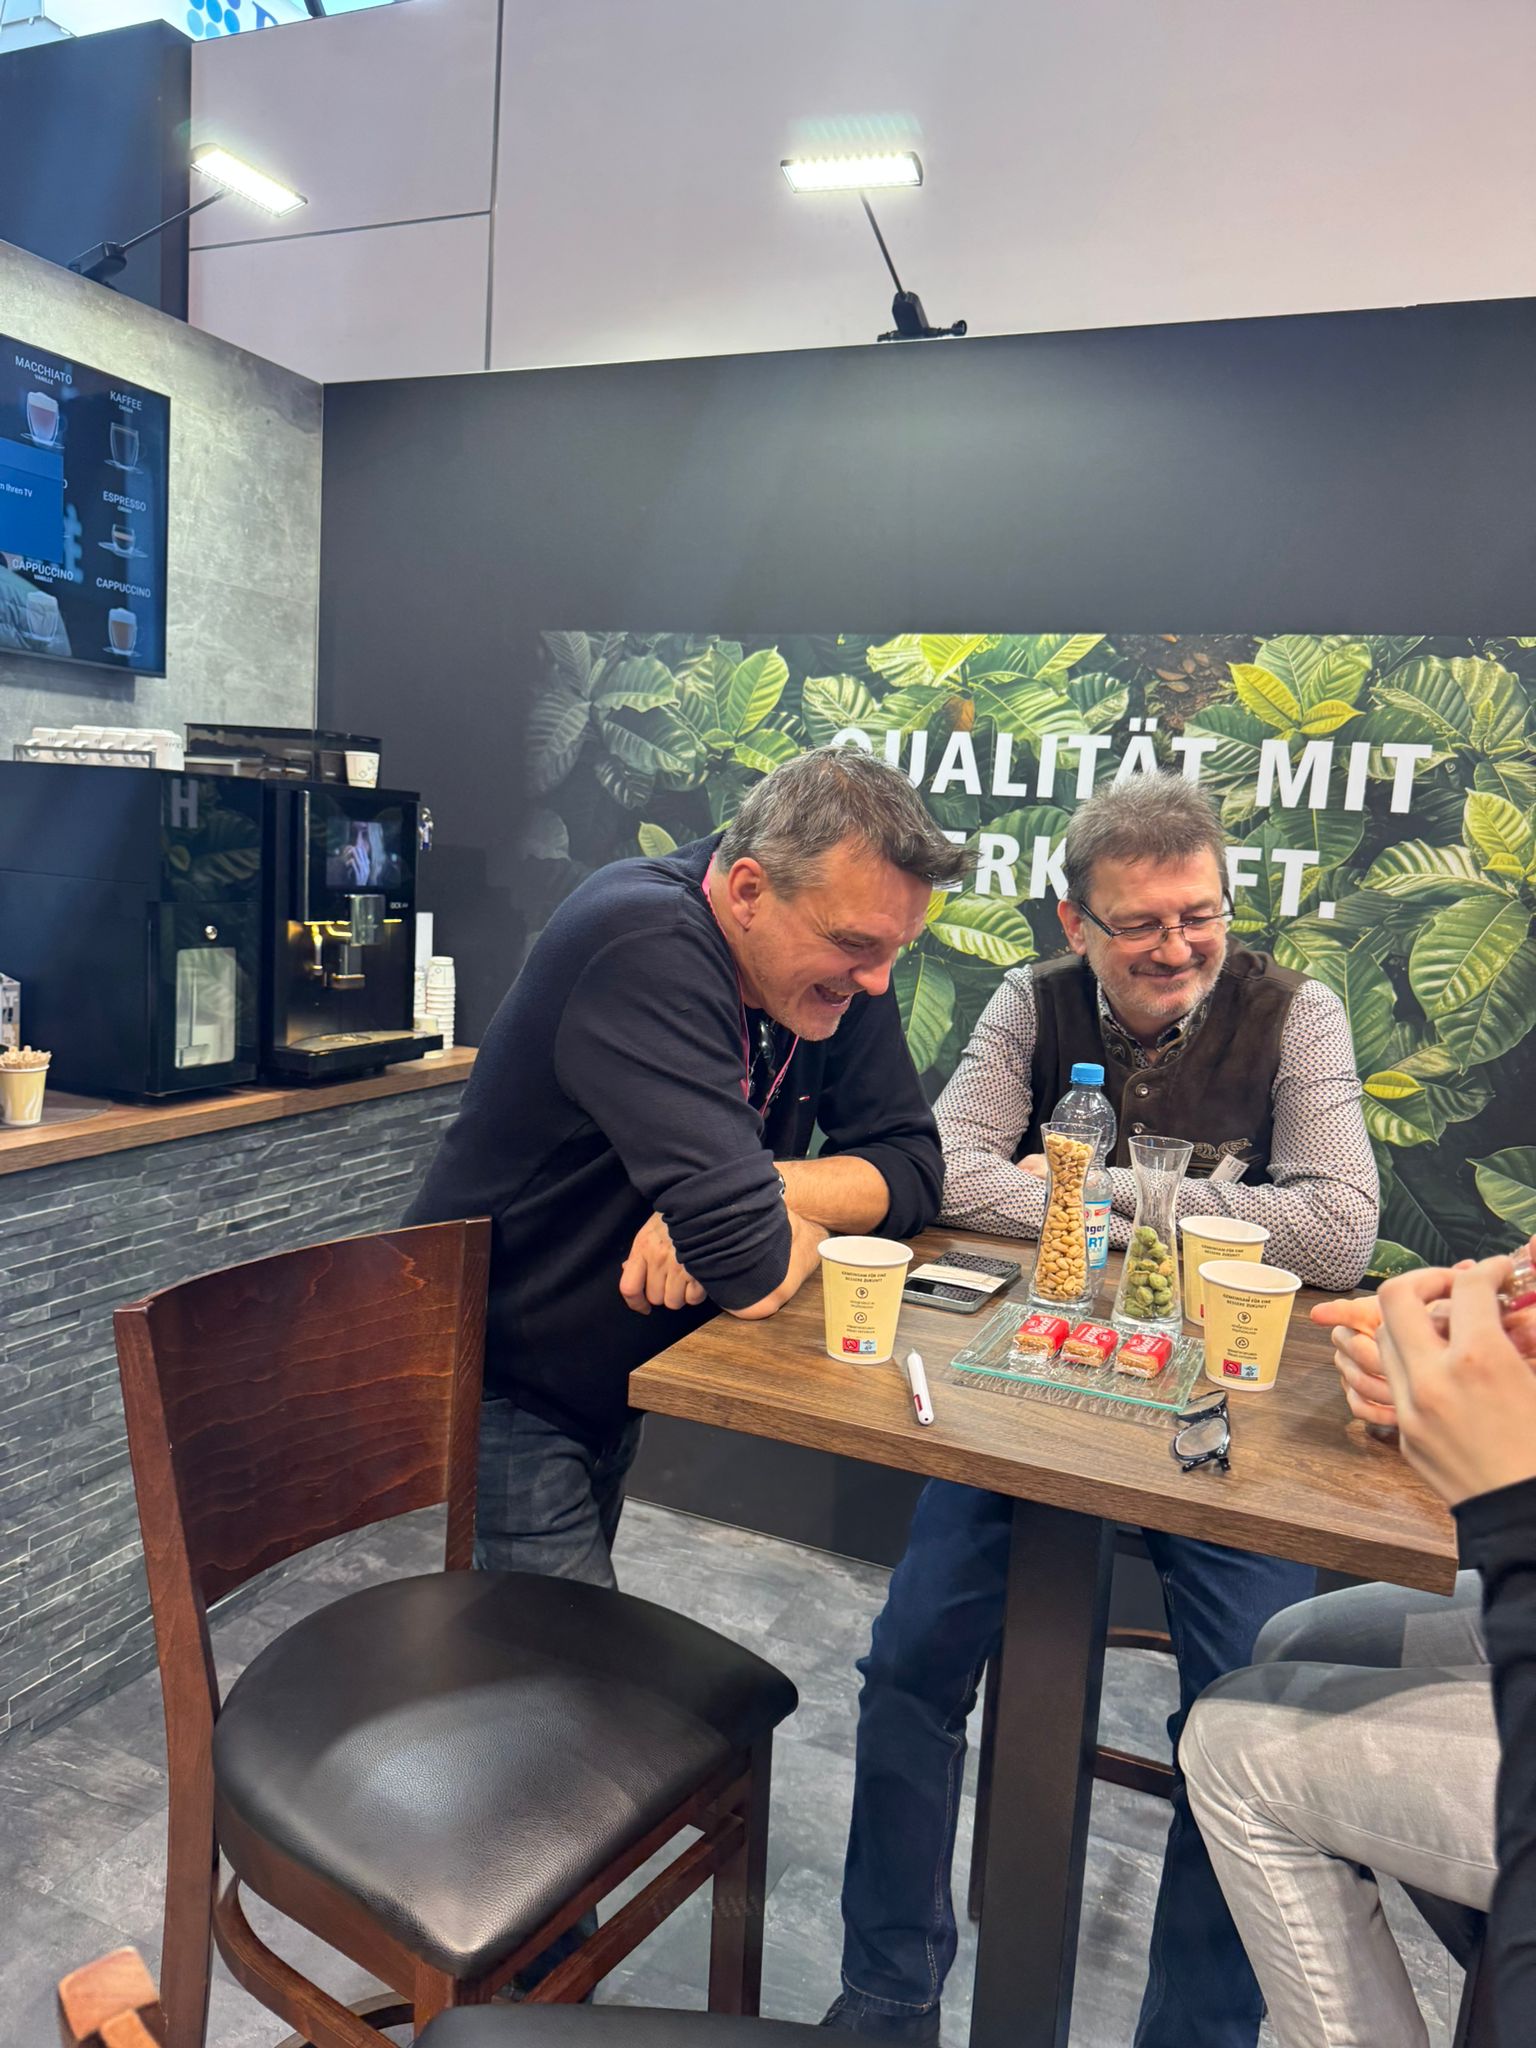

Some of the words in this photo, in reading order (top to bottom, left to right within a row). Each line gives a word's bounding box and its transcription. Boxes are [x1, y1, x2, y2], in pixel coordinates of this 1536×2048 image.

[15, 355, 73, 385] MACCHIATO
[110, 390, 142, 411] KAFFEE
[24, 488, 33, 497] TV
[103, 490, 147, 512] ESPRESSO
[12, 558, 74, 581] CAPPUCCINO
[96, 577, 151, 598] CAPPUCCINO
[1255, 739, 1433, 814] MIT
